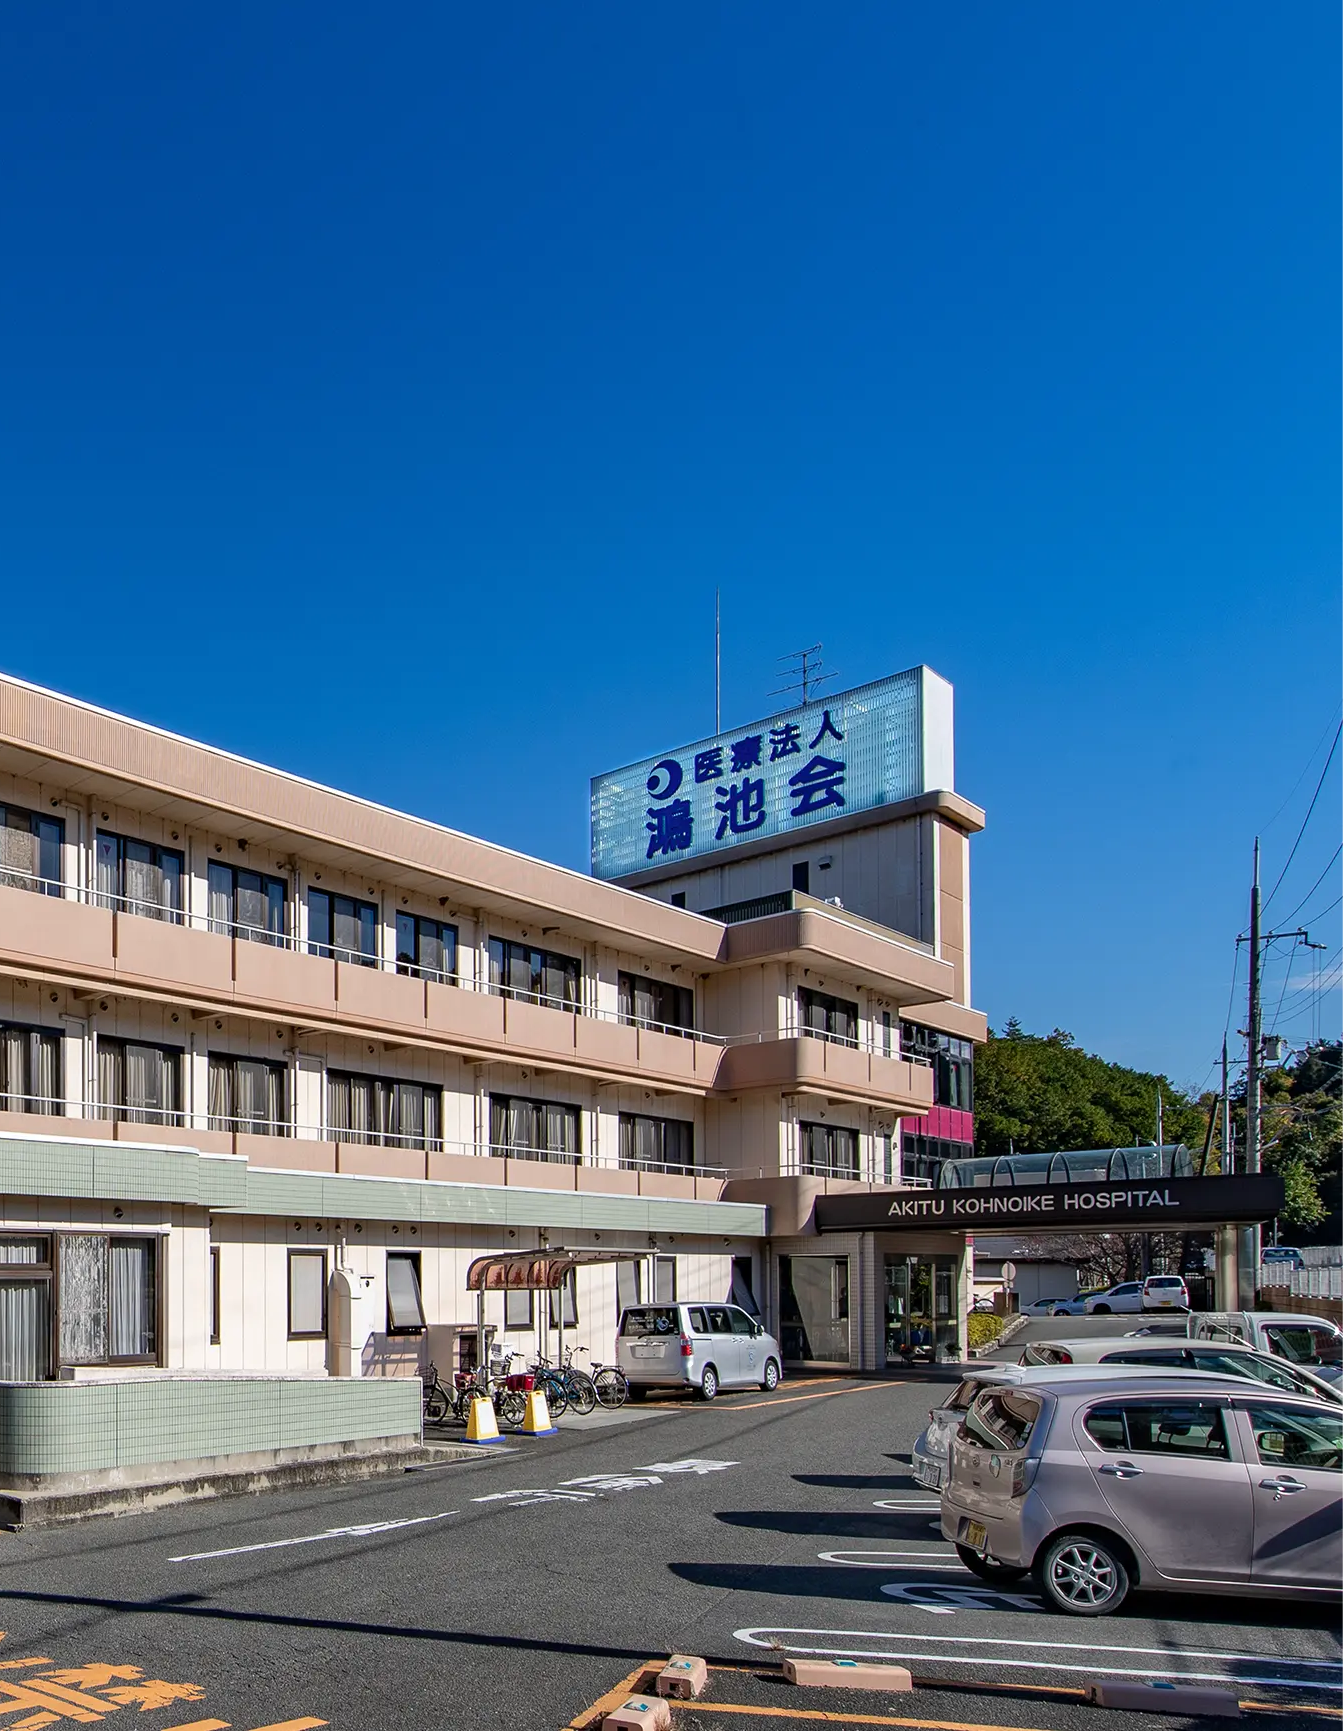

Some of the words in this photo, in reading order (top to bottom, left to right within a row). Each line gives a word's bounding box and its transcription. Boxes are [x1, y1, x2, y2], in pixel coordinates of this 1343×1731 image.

[694, 710, 844, 783] 医療法人
[646, 755, 846, 859] 鴻池会
[888, 1199, 945, 1217] AKITU
[952, 1195, 1054, 1214] KOHNOIKE
[1063, 1190, 1180, 1210] HOSPITAL
